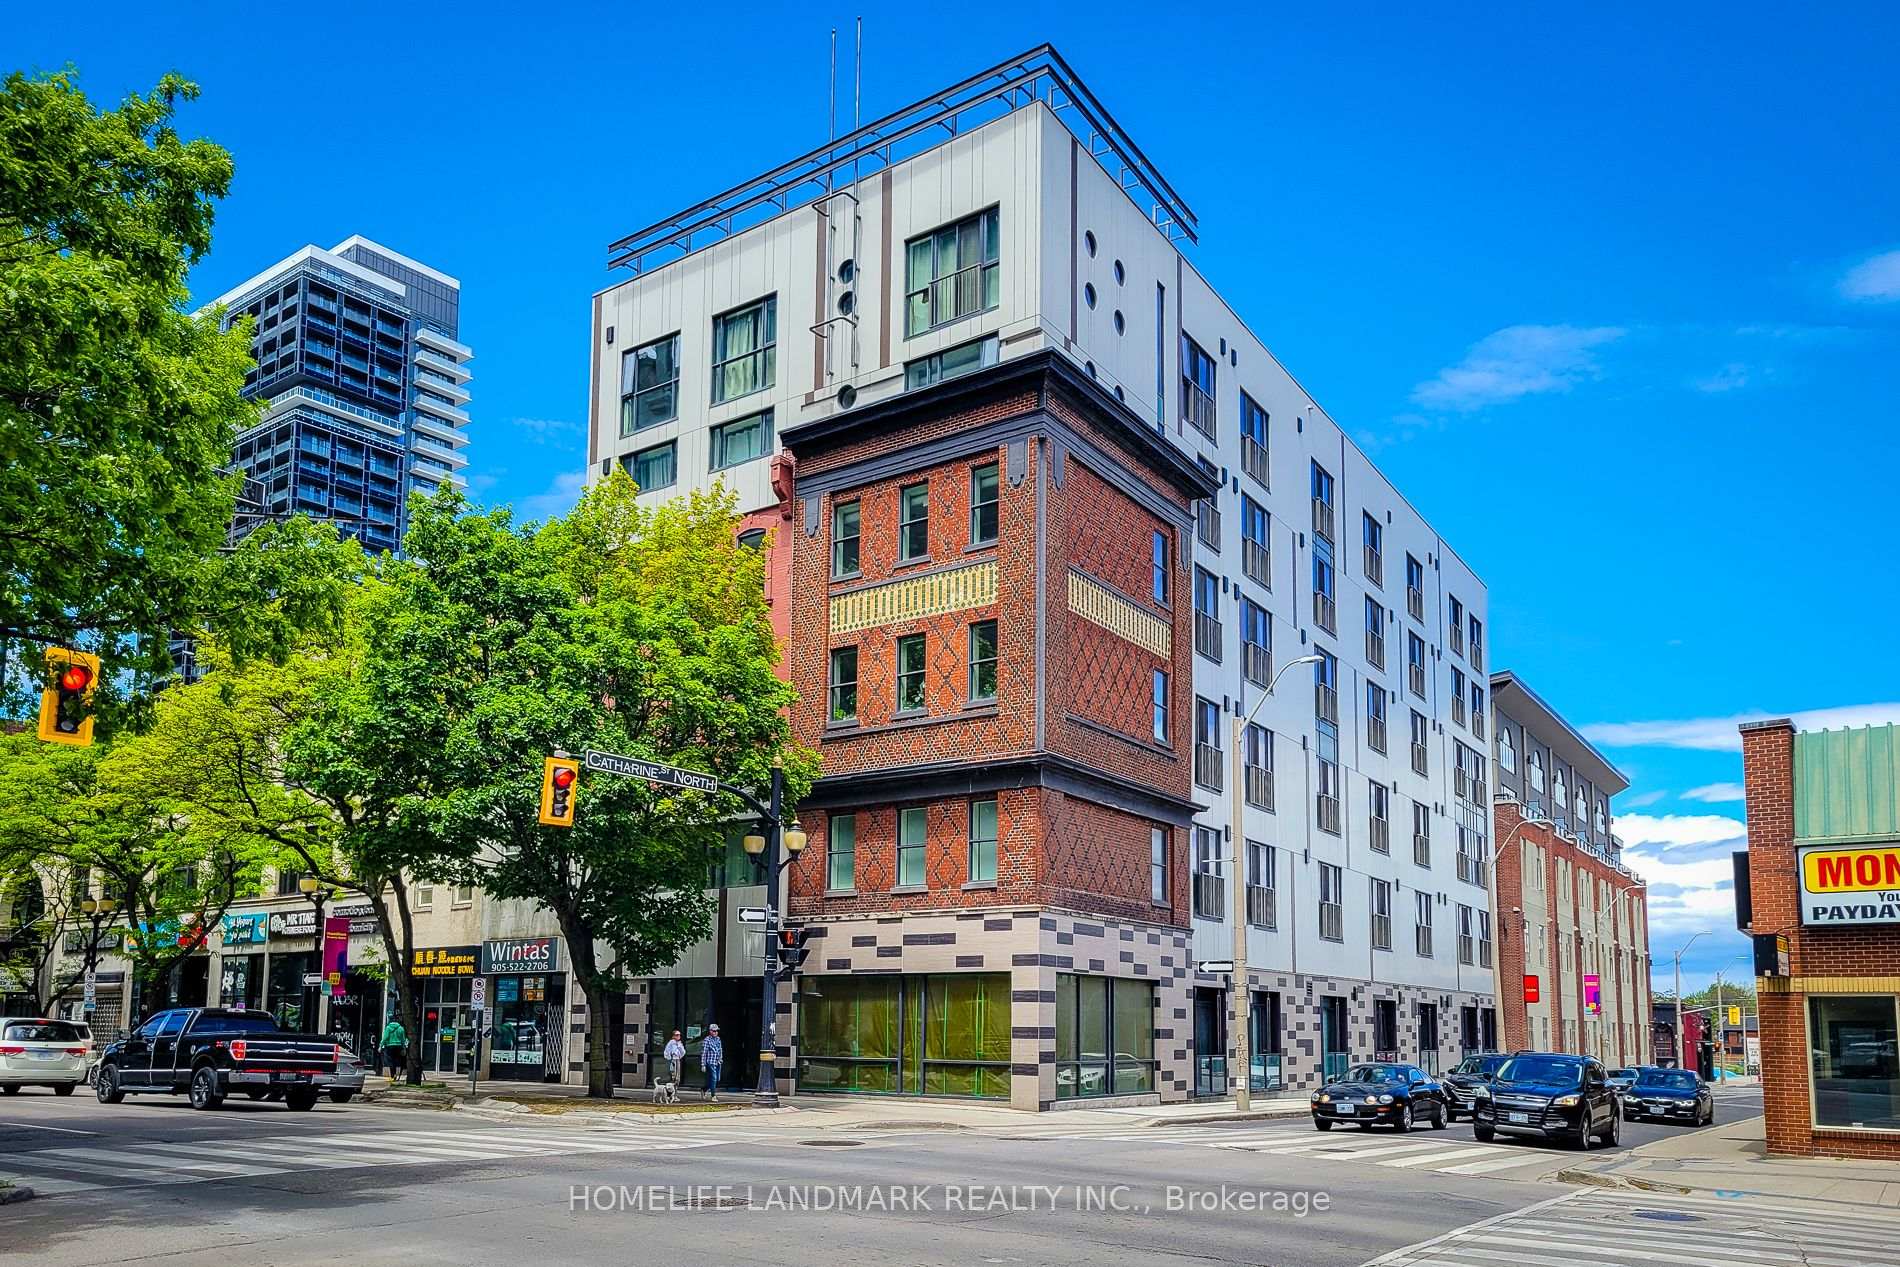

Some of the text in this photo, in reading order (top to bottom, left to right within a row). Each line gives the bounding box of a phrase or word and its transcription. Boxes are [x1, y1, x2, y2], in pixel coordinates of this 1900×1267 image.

[589, 753, 659, 778] CATHARINE
[674, 769, 714, 790] NORTH
[490, 942, 550, 961] Wintas
[491, 961, 549, 972] 905-522-2706
